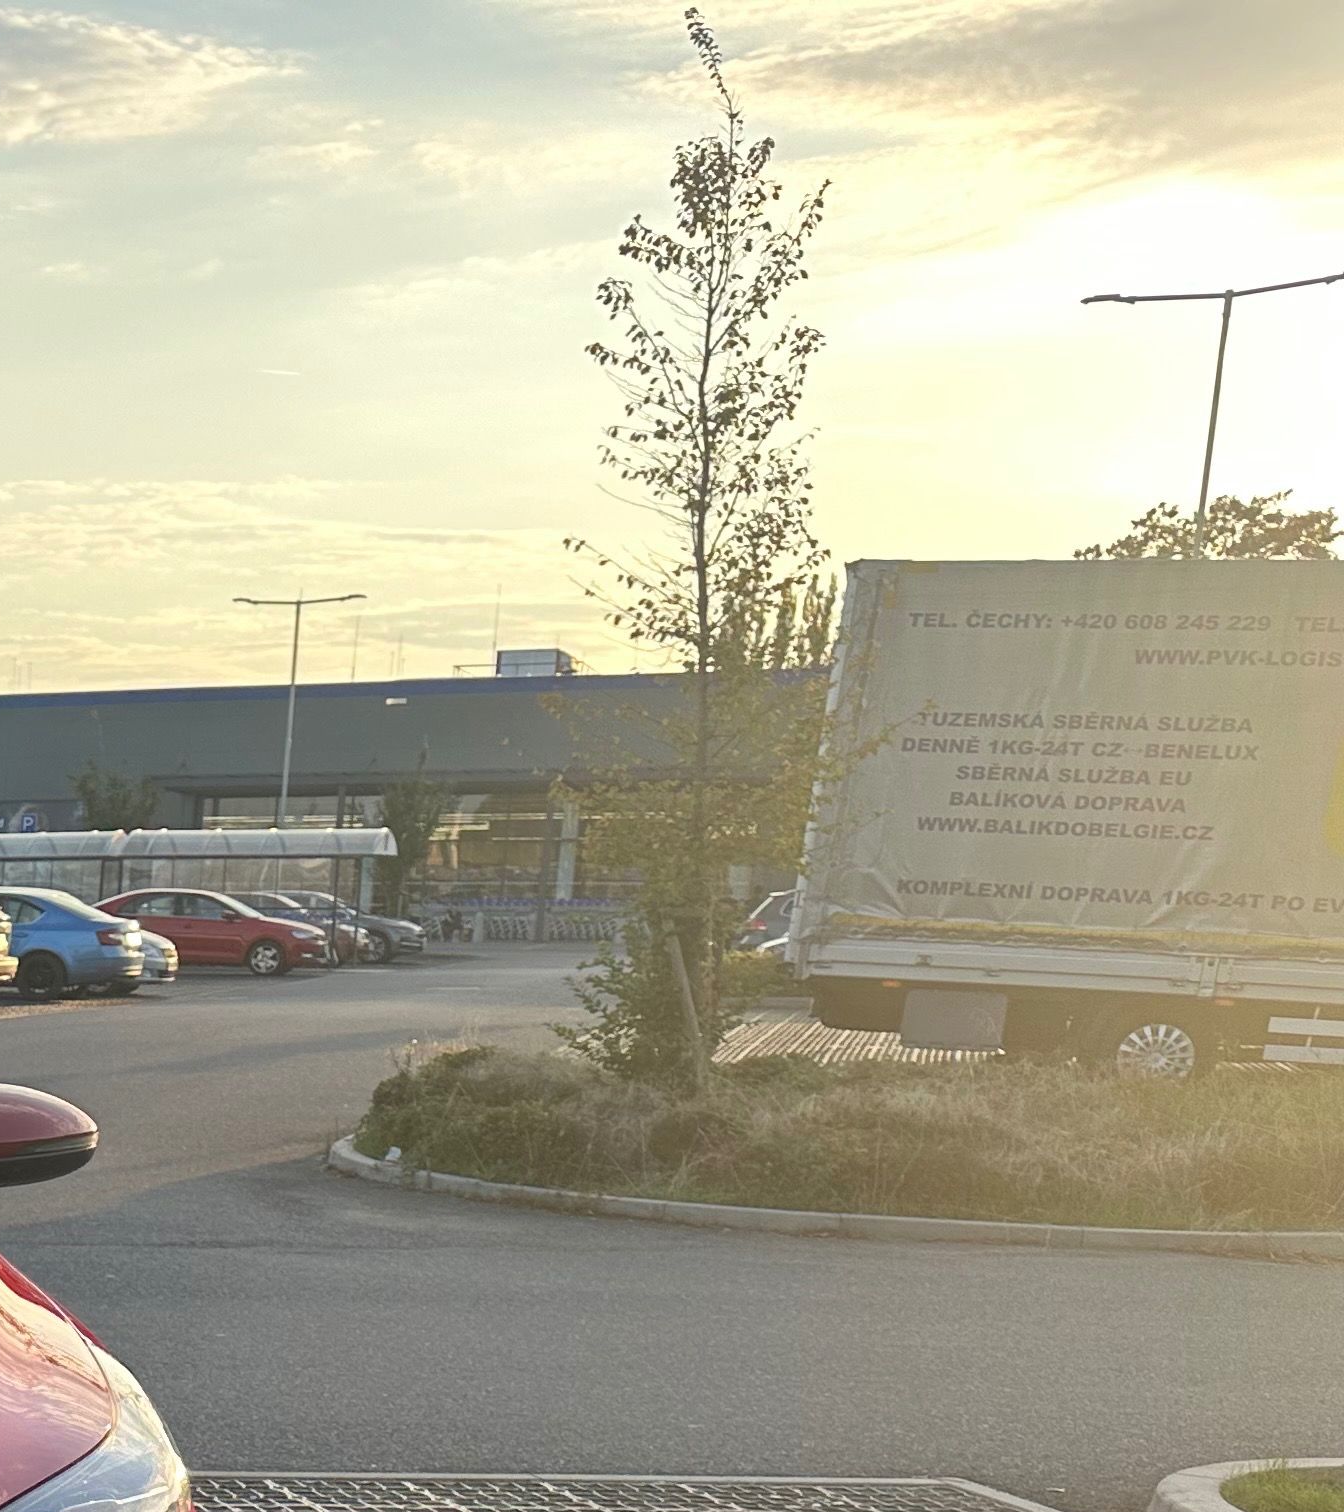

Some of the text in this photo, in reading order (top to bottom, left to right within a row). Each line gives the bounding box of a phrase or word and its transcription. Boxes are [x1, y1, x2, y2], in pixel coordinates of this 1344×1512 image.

[909, 609, 1271, 632] TEL. ČECHY: +420 608 245 229
[1052, 712, 1149, 732] SBĚRNÁ
[1157, 714, 1253, 734] SLUŽBA
[901, 736, 980, 755] DENNĚ
[988, 739, 1085, 757] 1KG-24T
[956, 763, 1192, 786] SBĚRNÁ SLUŽBA EU
[949, 790, 1186, 813] BALÍKOVÁ DOPRAVA
[917, 817, 1214, 841] WWW.BALIKDOBELGIE.CZ
[897, 878, 1034, 899] KOMPLEXNÍ
[1041, 885, 1152, 904] DOPRAVA
[1162, 891, 1264, 909] 1KG-24T
[1271, 895, 1305, 911] PO
